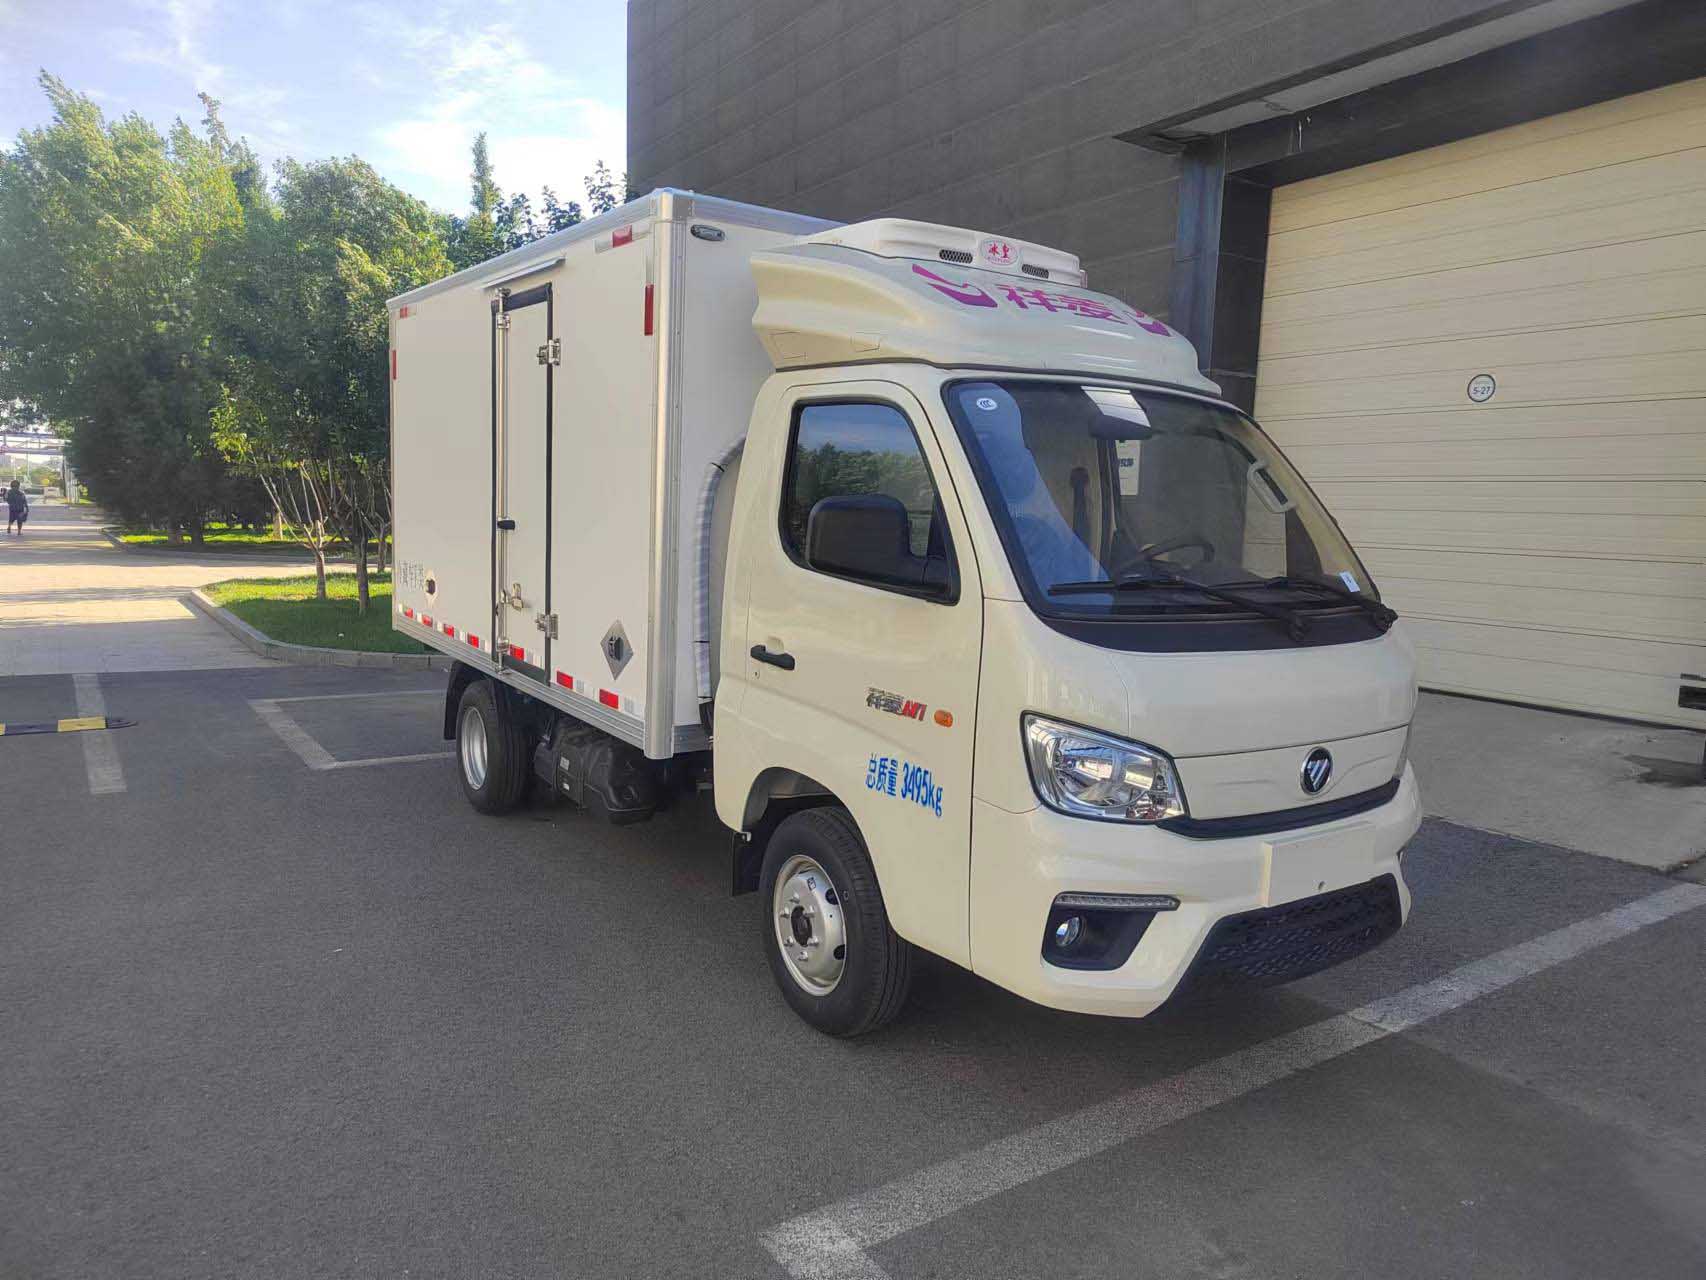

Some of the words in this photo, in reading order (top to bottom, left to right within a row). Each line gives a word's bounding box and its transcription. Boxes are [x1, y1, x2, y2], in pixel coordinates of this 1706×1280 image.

[865, 753, 898, 796] 总质量
[901, 762, 943, 817] 3495kg
